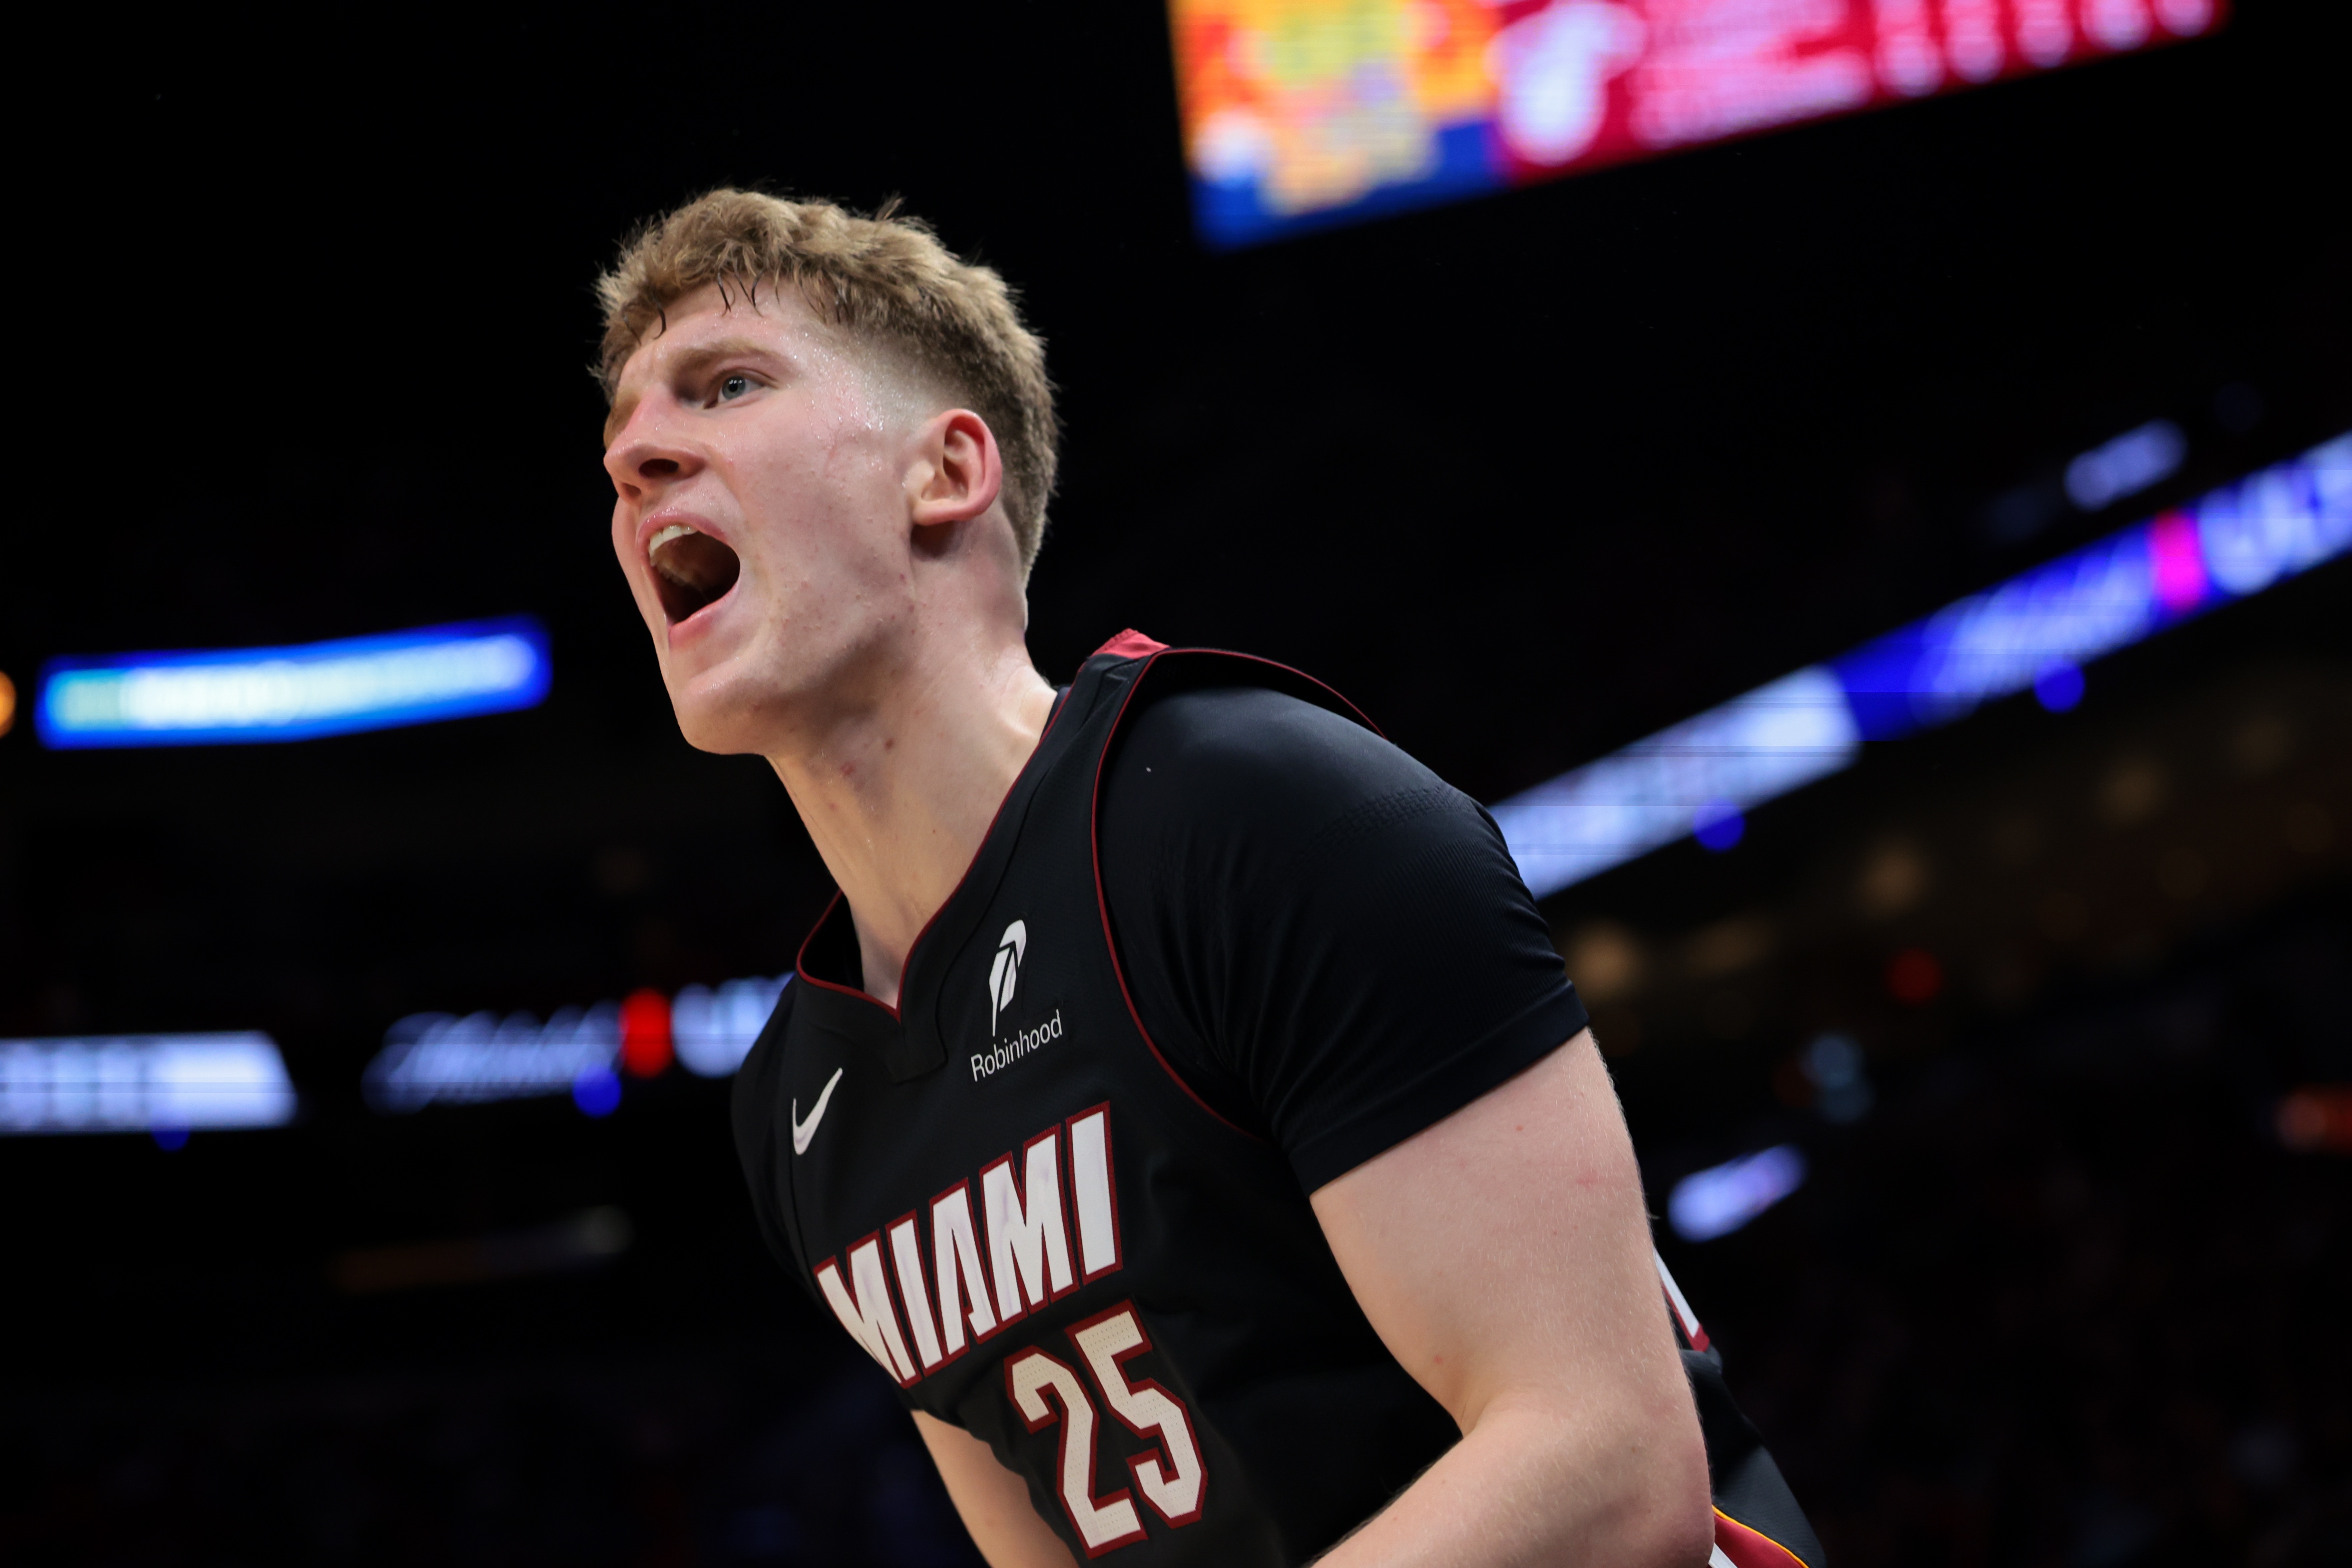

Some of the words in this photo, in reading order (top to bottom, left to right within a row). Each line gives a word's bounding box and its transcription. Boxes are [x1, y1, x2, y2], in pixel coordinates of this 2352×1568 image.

[970, 1008, 1062, 1082] Robinhood
[814, 1102, 1122, 1388] MIAMI
[1004, 1298, 1208, 1559] 25
